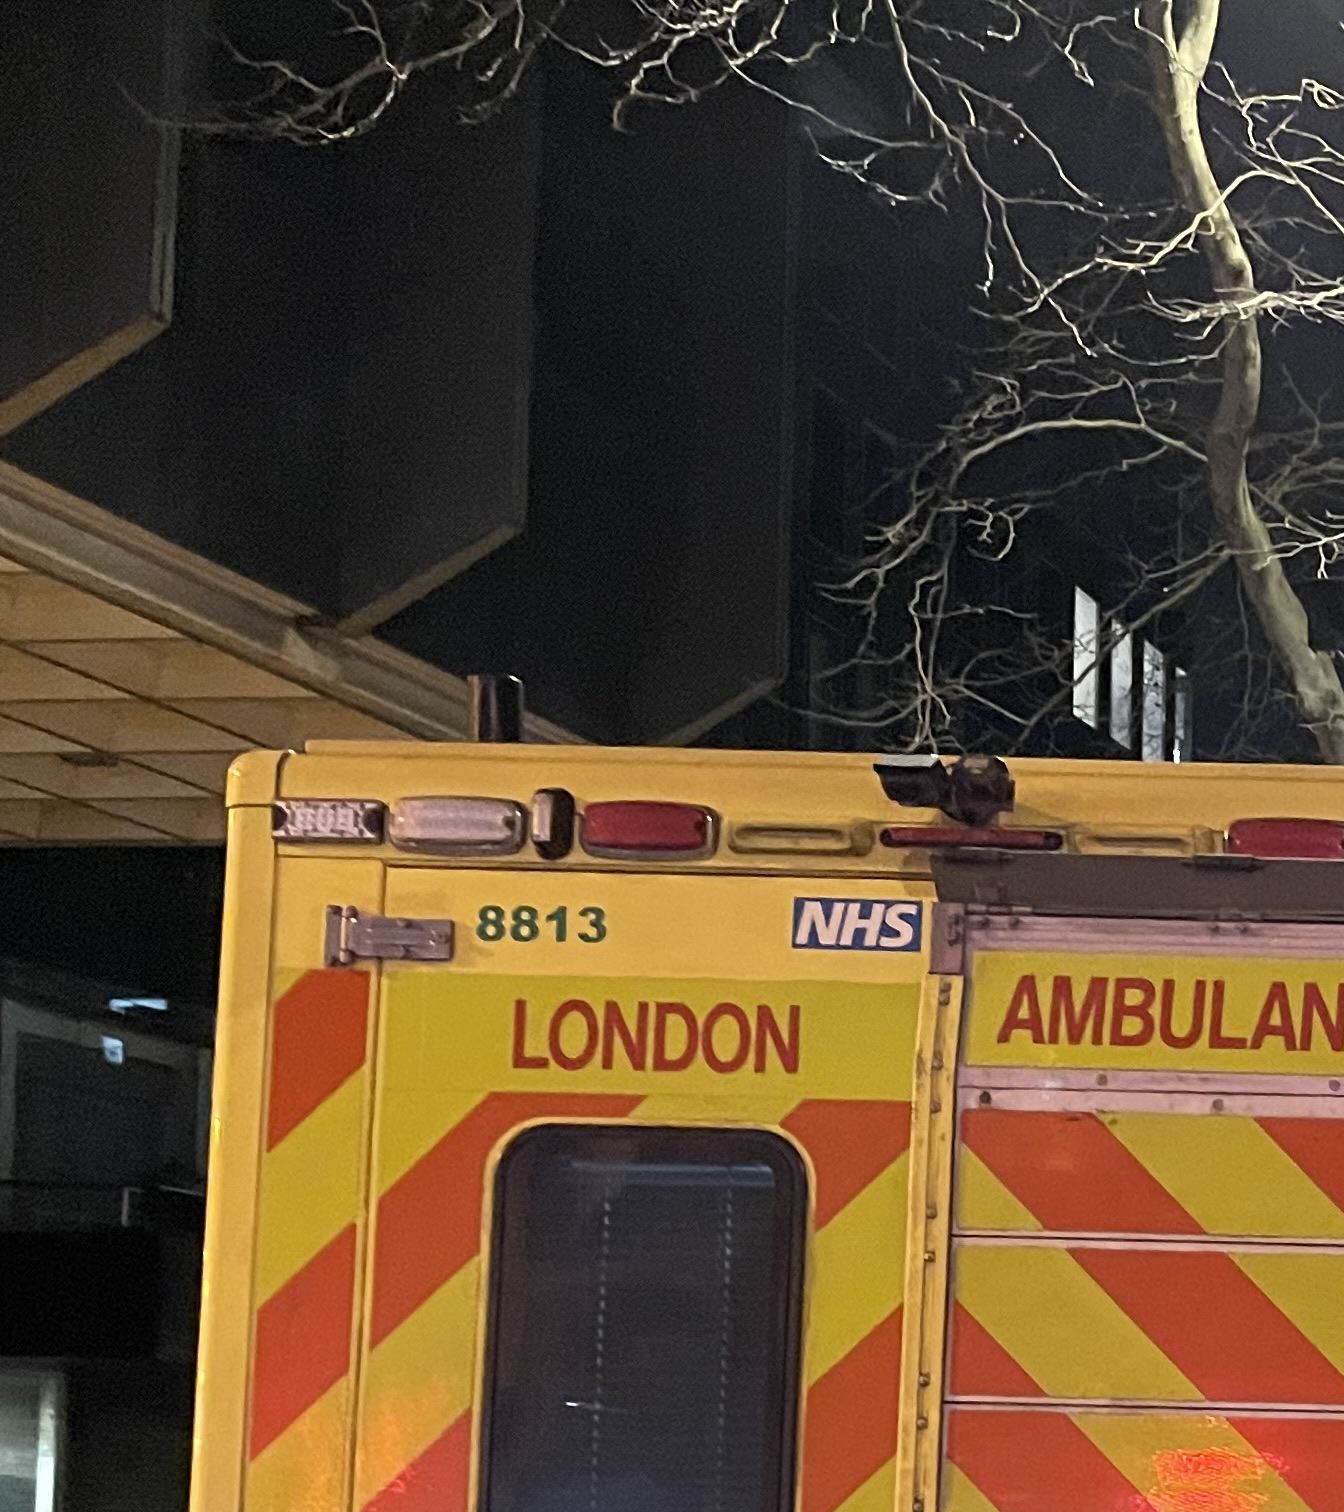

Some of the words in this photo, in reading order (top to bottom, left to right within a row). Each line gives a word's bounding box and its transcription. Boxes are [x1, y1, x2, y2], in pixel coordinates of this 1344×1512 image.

[476, 905, 608, 943] 8813
[796, 901, 918, 948] NHS
[512, 998, 801, 1074] LONDON
